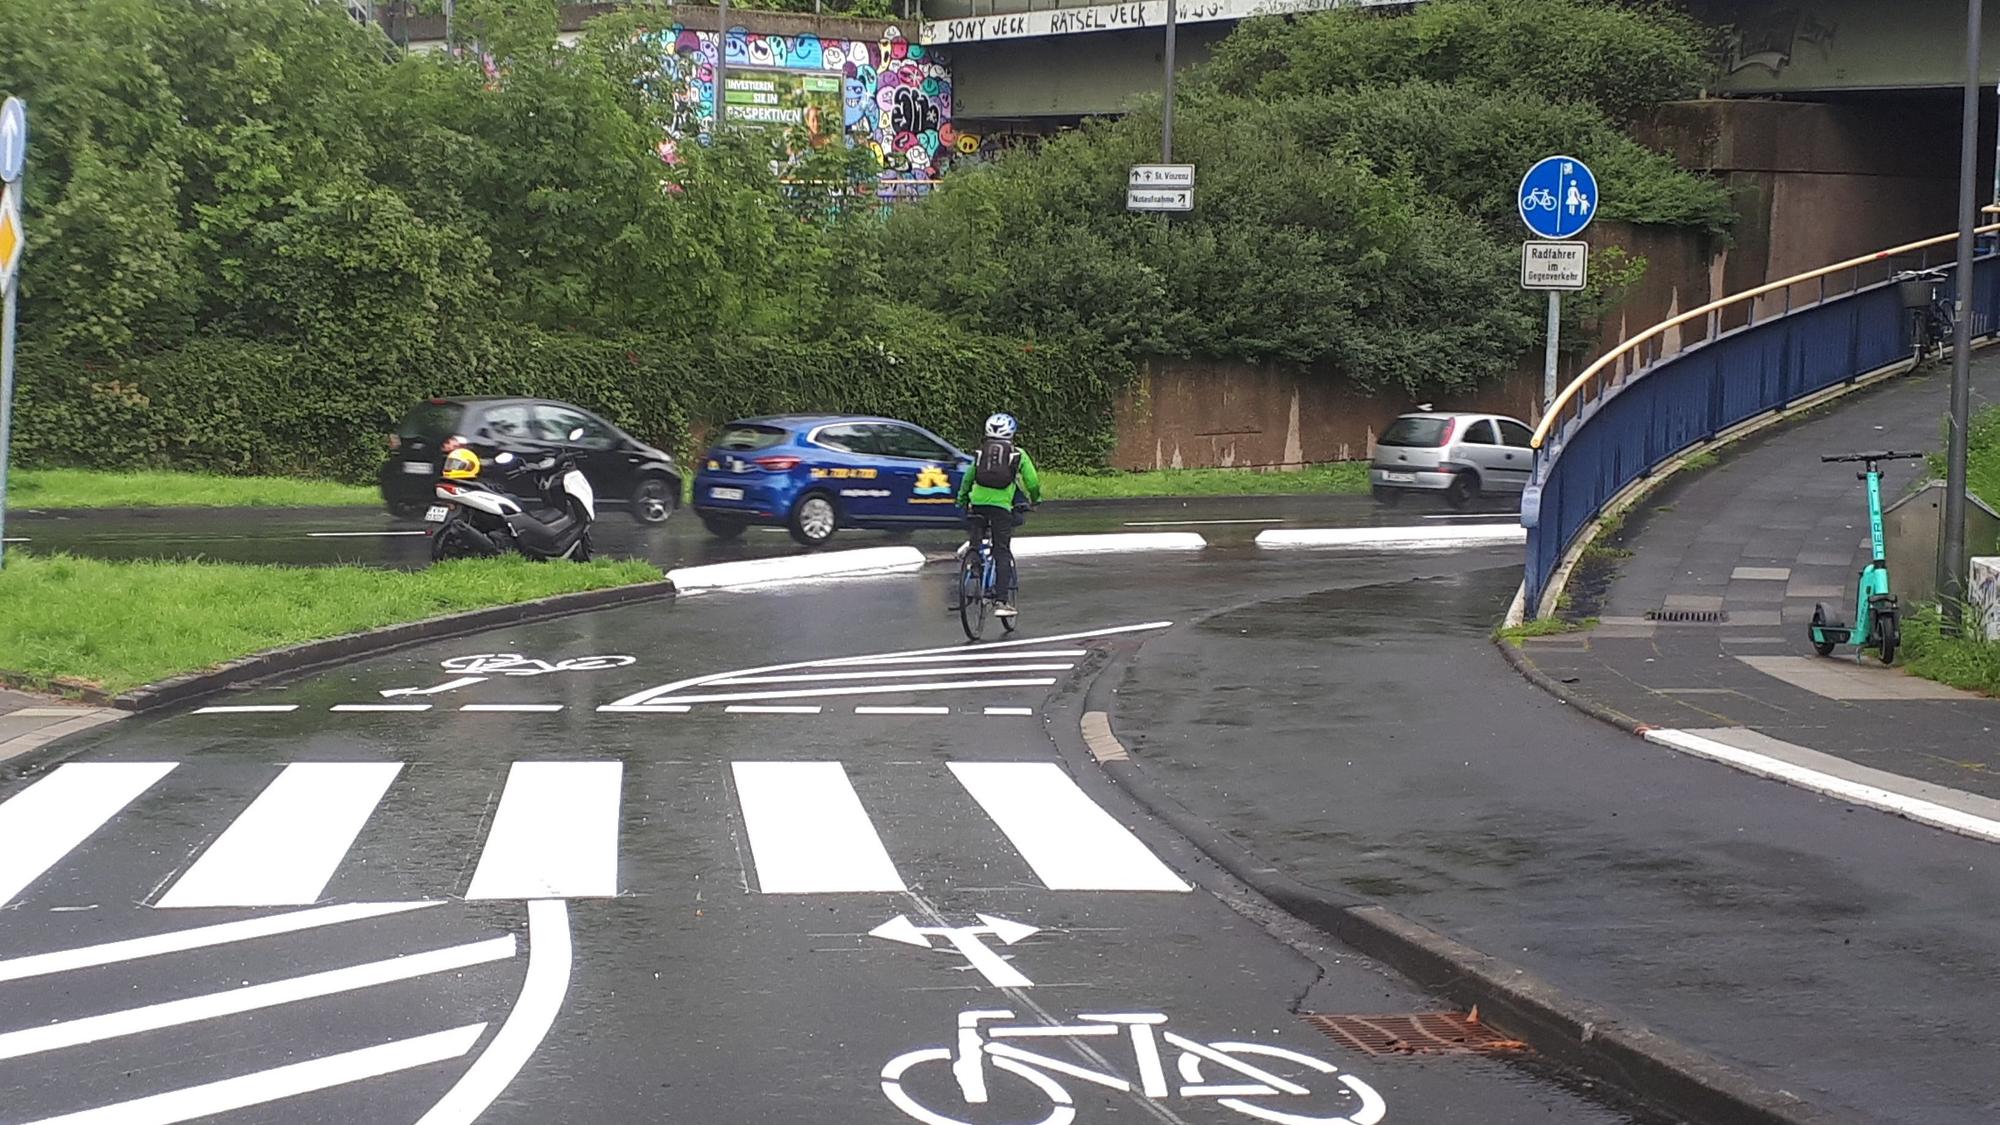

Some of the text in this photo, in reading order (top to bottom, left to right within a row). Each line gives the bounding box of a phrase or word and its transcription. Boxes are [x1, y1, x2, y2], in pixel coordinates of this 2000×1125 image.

[1110, 2, 1146, 27] JECK
[993, 17, 1025, 36] JECK
[728, 80, 774, 91] INVESTIEREN
[767, 93, 778, 104] IN
[1531, 248, 1577, 259] Radfahrer
[1548, 261, 1559, 271] im
[1528, 271, 1578, 281] Gegenverkehr
[1873, 522, 1883, 558] TIER
